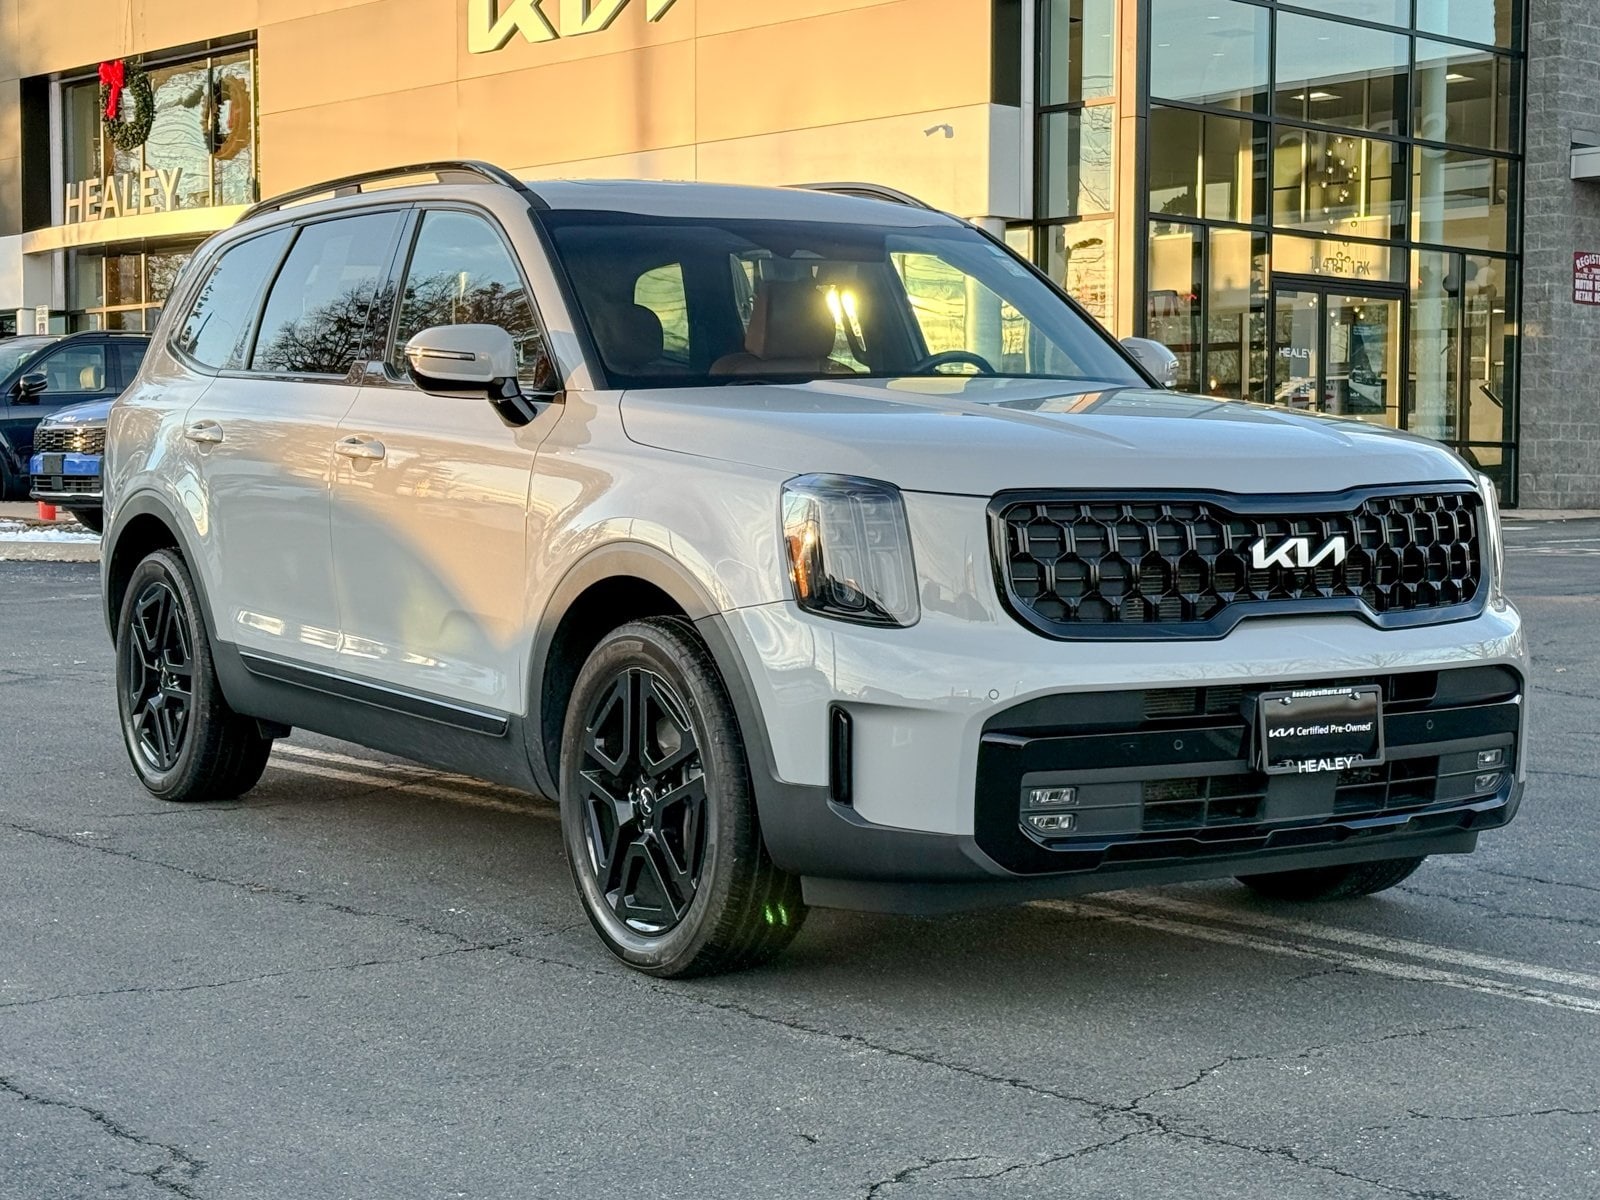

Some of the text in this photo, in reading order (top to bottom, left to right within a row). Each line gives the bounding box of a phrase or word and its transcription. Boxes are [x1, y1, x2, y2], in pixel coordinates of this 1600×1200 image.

[468, 0, 674, 54] KI
[65, 167, 181, 224] HEALEY
[1575, 254, 1600, 271] REGIST
[1278, 347, 1313, 359] HEALEY
[1252, 536, 1346, 569] KIA
[1268, 722, 1371, 738] KIA Certified Pre-Owned
[1298, 756, 1353, 773] HEALEY
